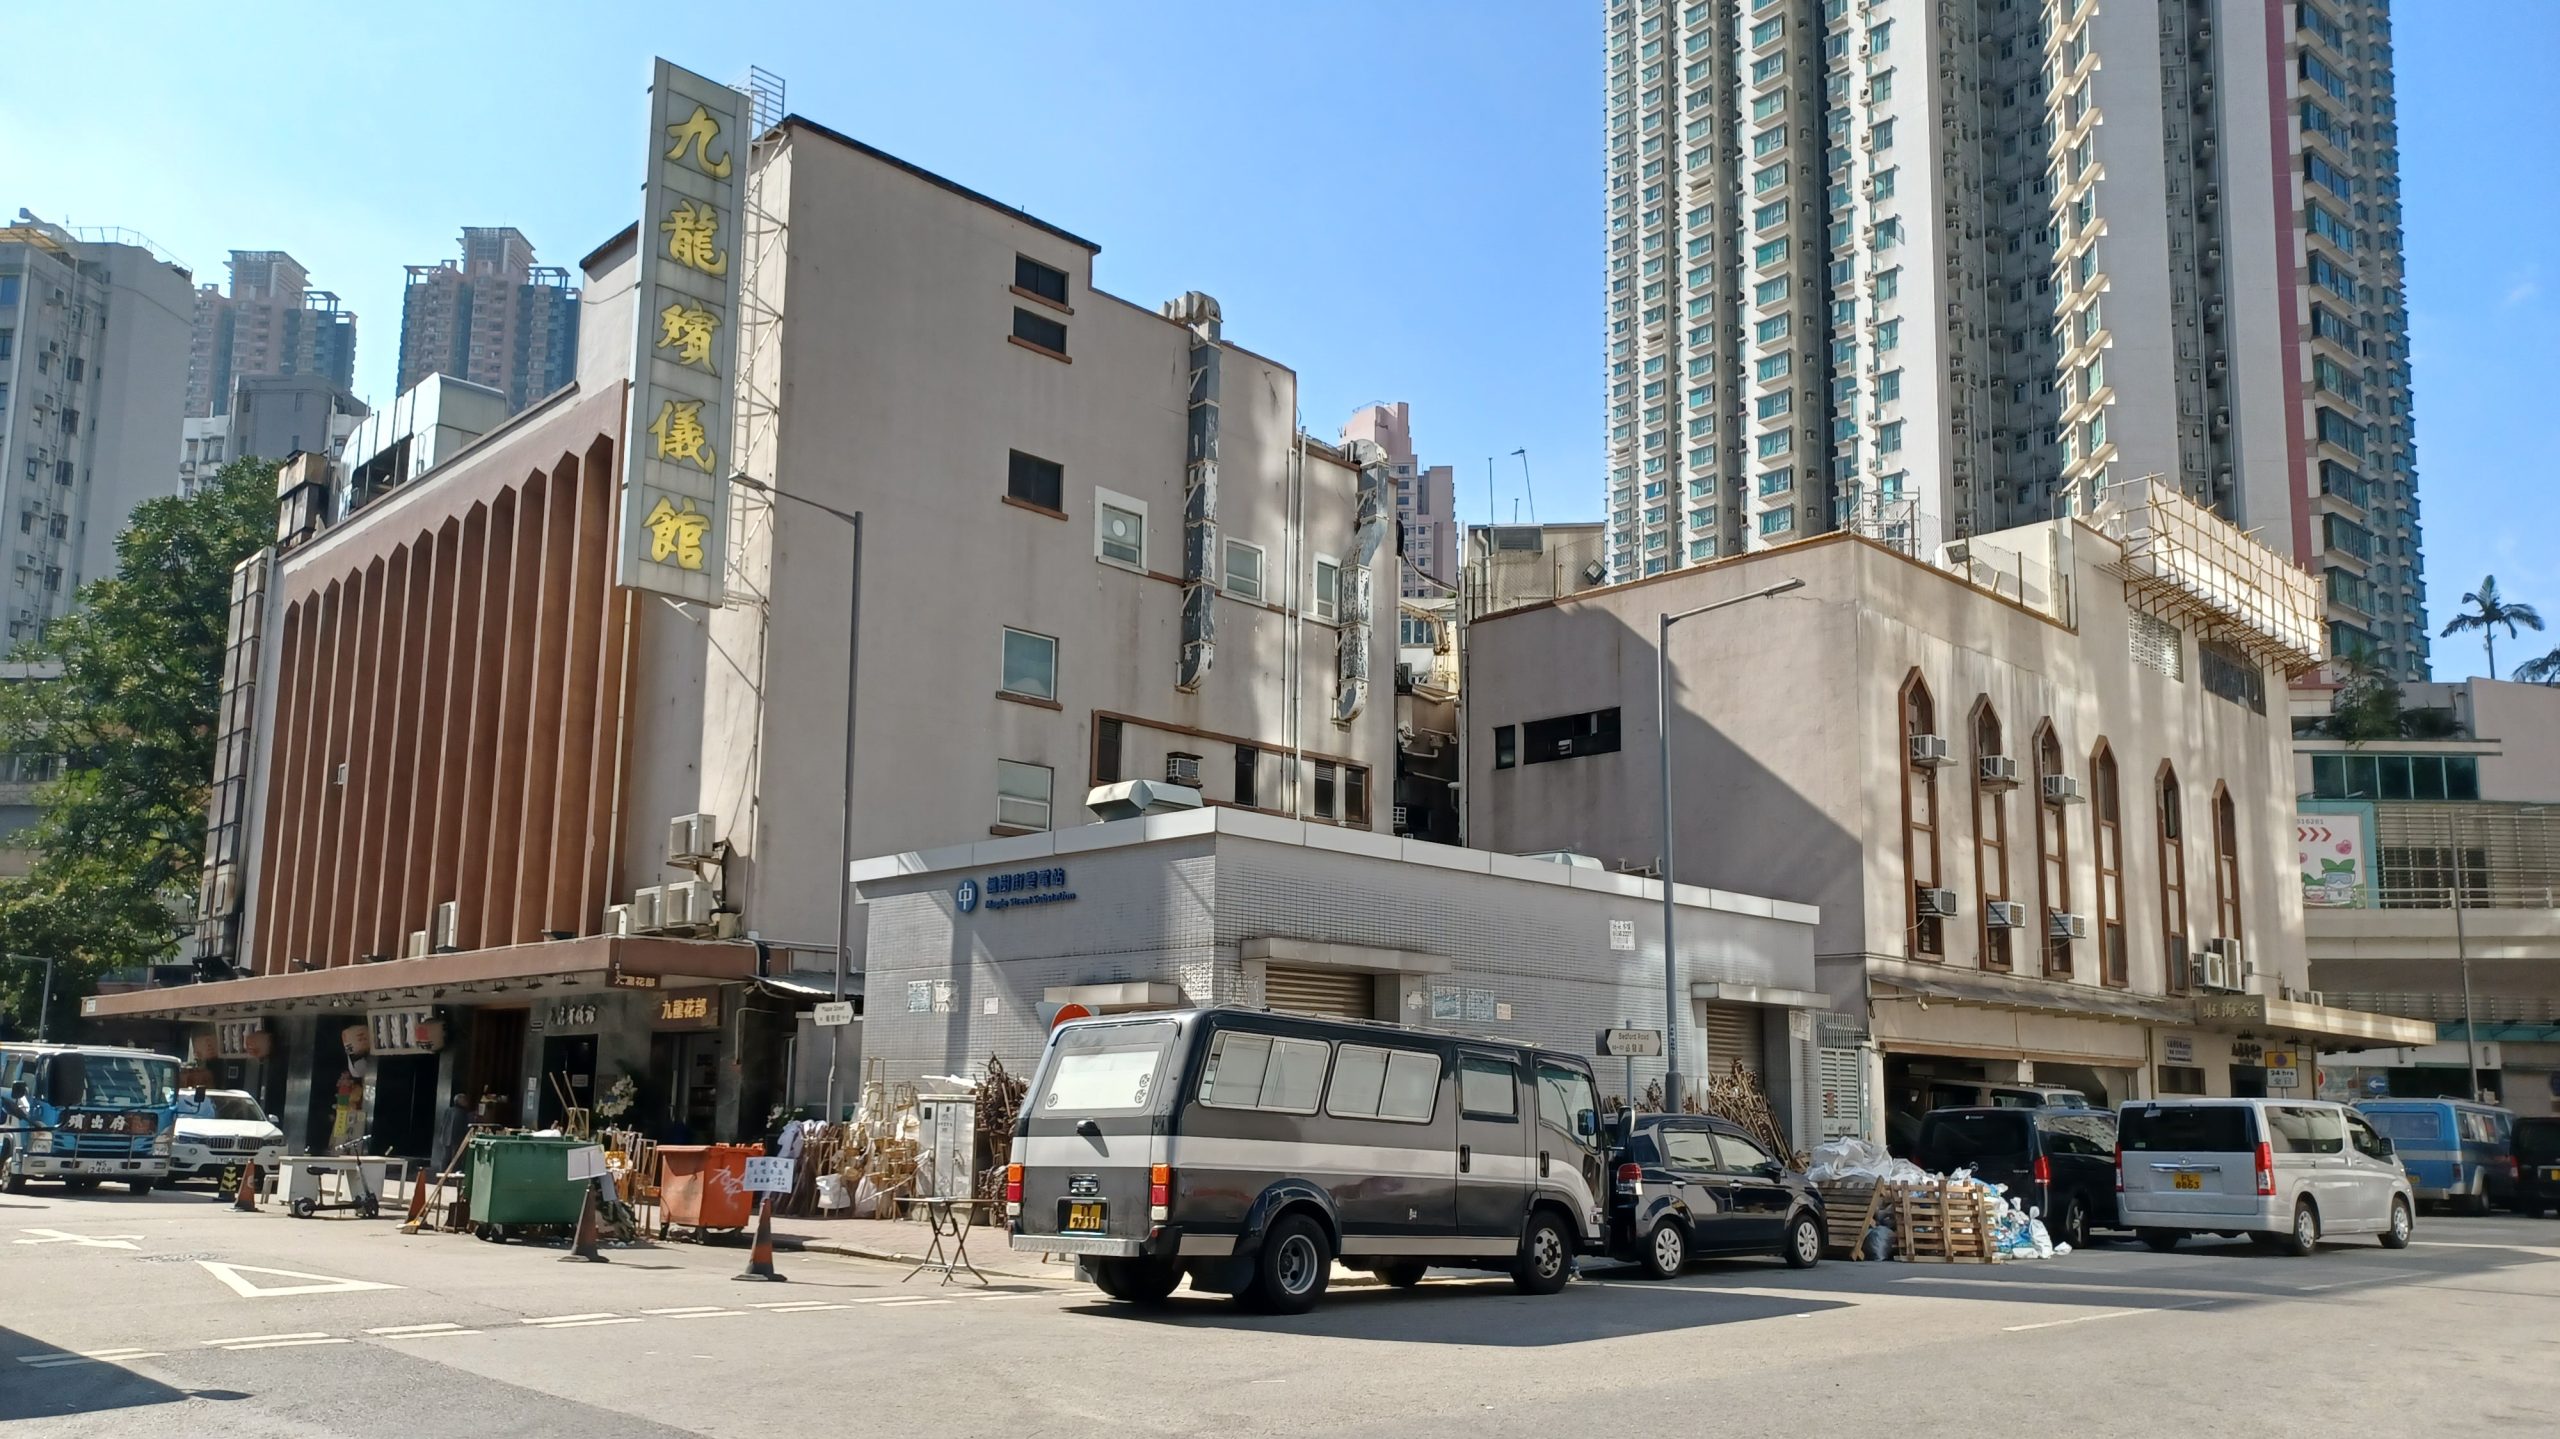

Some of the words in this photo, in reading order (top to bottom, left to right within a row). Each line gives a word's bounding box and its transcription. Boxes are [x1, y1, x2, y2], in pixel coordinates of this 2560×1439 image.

[641, 105, 732, 571] 九龍殯儀館
[661, 997, 708, 1020] 九龍花部
